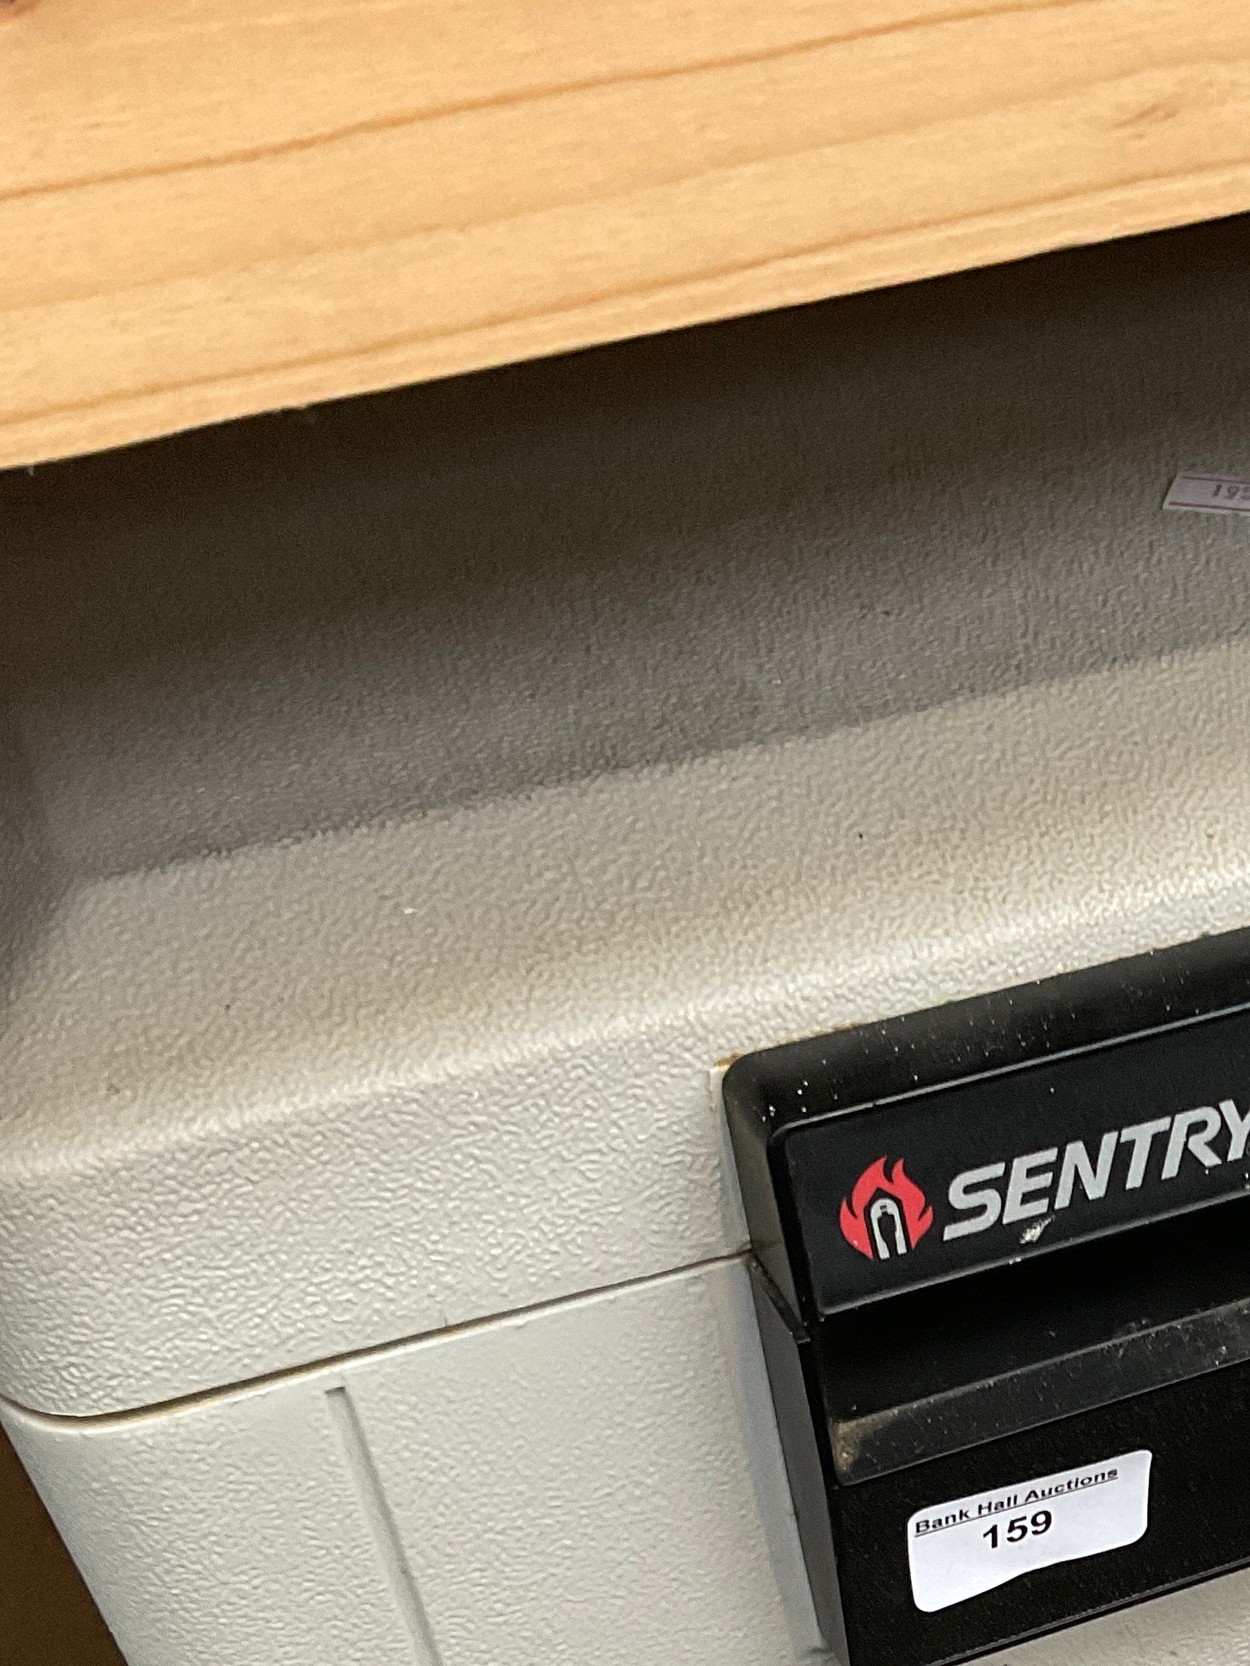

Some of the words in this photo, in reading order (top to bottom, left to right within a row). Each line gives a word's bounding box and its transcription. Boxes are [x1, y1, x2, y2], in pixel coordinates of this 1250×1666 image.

[914, 1508, 970, 1535] Bank
[977, 1495, 1018, 1516] Hall
[1024, 1468, 1119, 1503] Auctions
[982, 1510, 1053, 1549] 159
